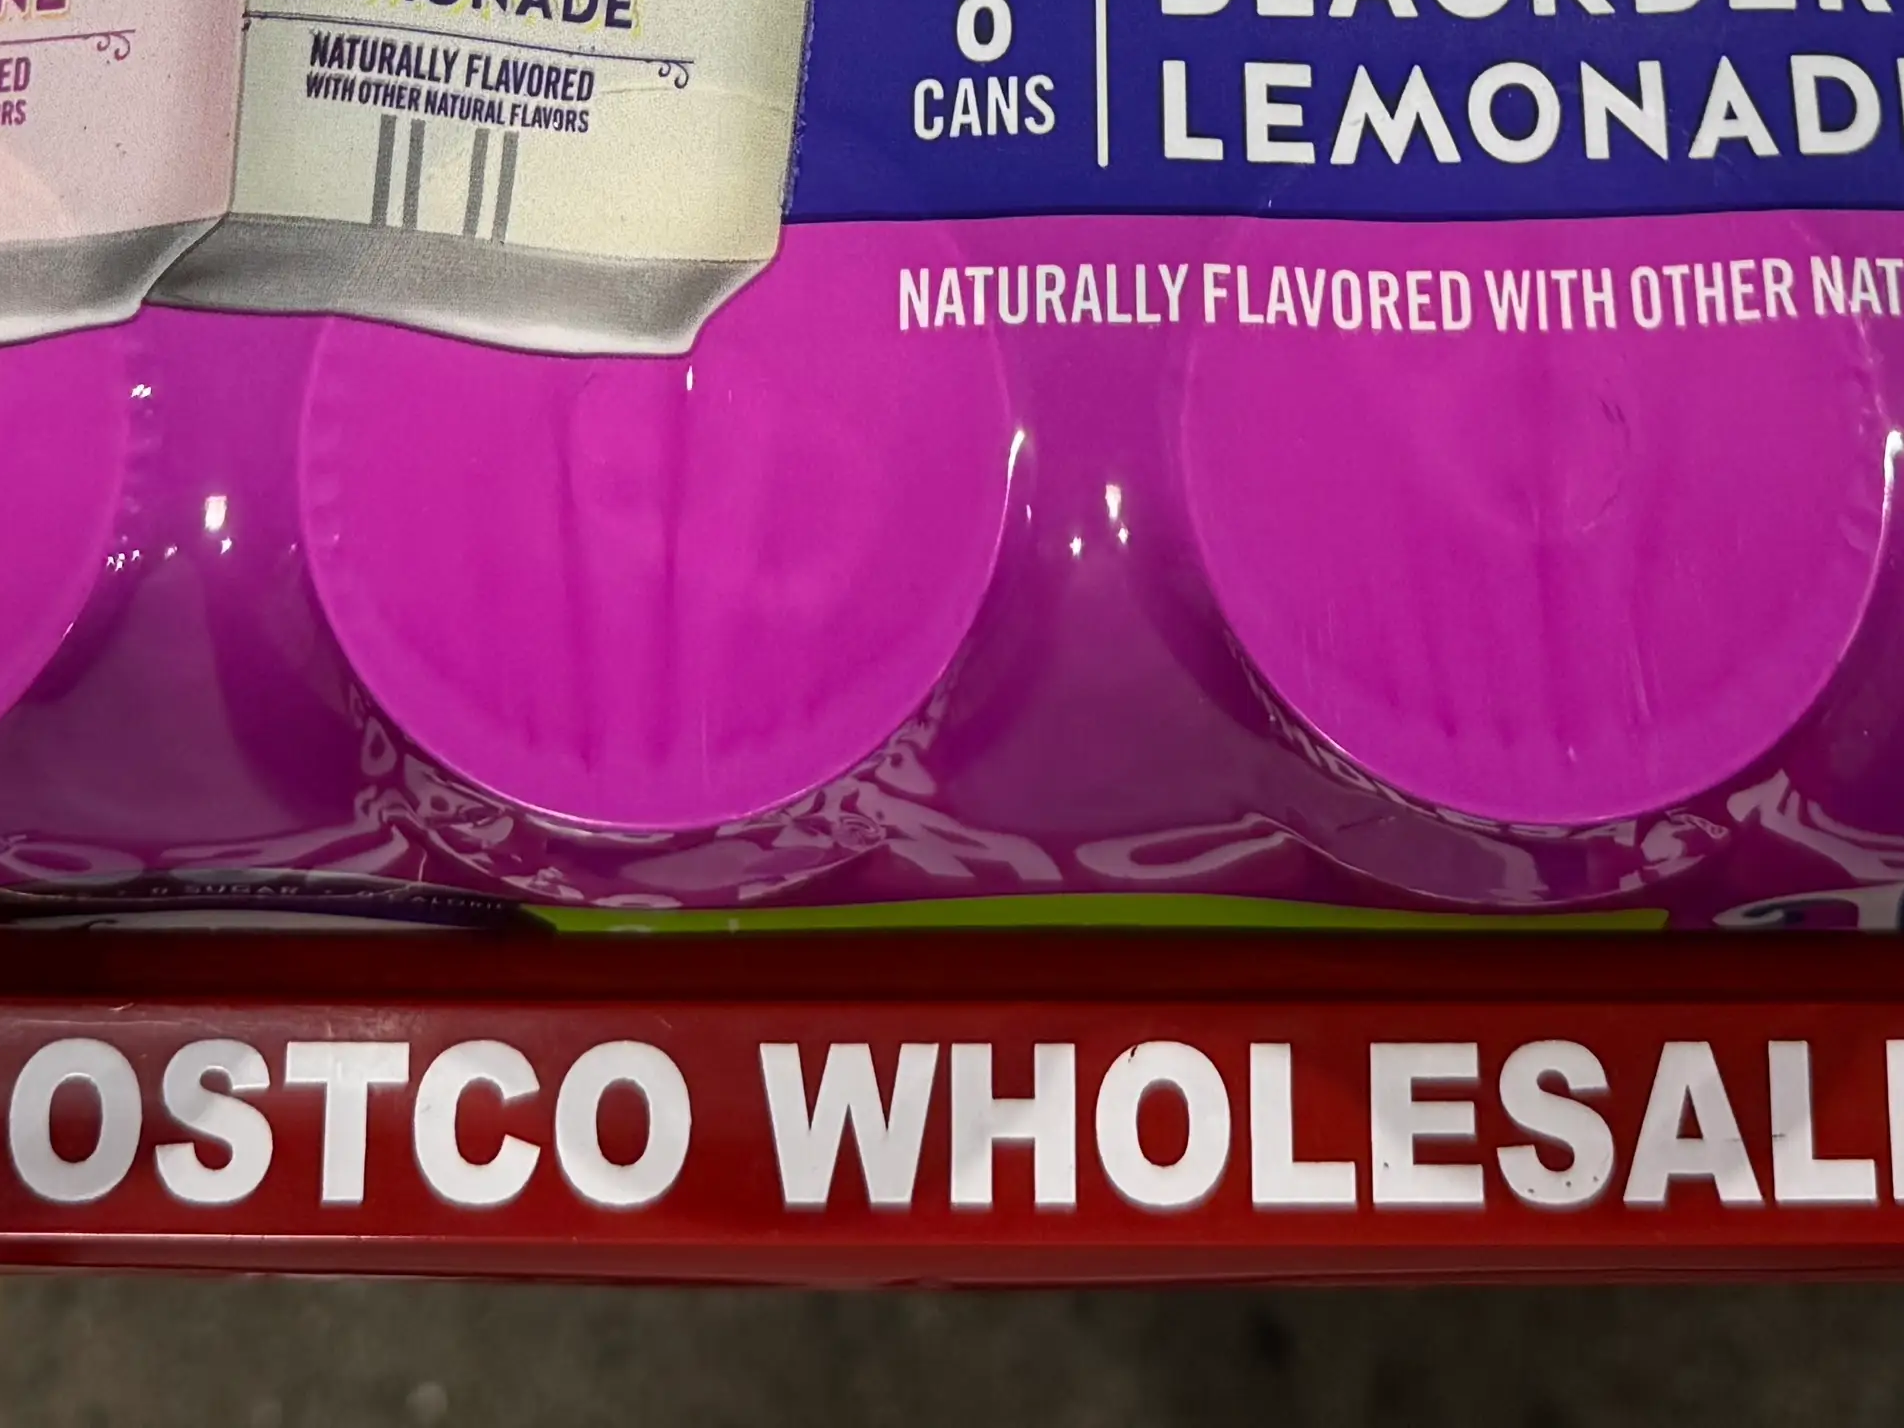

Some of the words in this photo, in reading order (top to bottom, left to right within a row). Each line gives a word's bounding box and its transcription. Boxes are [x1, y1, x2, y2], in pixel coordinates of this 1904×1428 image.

[308, 31, 458, 86] NATURALLY
[464, 52, 595, 102] FLAVORED
[305, 71, 355, 102] WITH
[357, 80, 421, 112] OTHER
[423, 91, 506, 126] NATURAL
[508, 102, 590, 134] FLAVORS
[912, 74, 1056, 140] CANS
[898, 262, 1190, 332] NATURALLY
[1203, 262, 1472, 333] FLAVORED
[1484, 266, 1616, 333] WITH
[1629, 255, 1798, 331] OTHER
